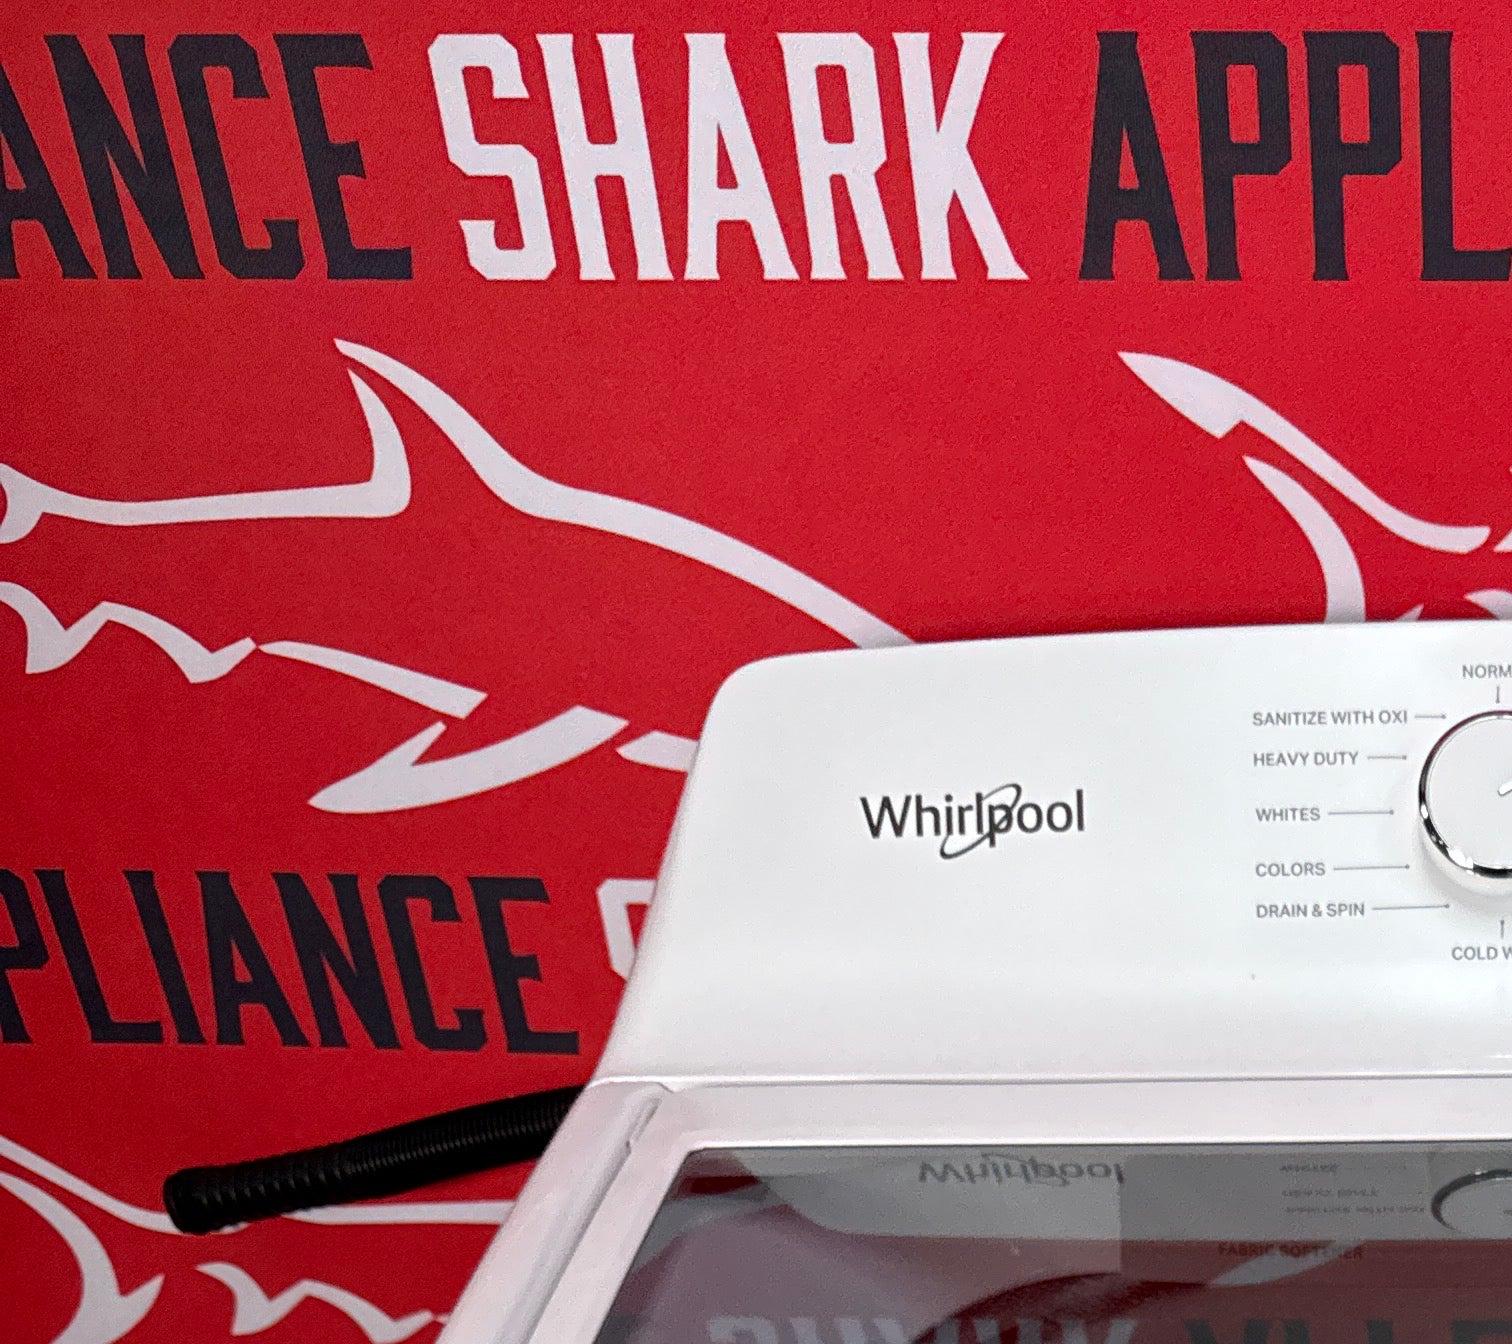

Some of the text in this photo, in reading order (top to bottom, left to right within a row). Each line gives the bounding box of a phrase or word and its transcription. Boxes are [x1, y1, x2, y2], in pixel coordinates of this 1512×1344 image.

[427, 31, 1029, 282] SHARK
[1252, 709, 1408, 726] SANITIZE WITH OXI
[1253, 751, 1359, 767] HEAVY DUTY
[859, 783, 1085, 860] Whirlpool
[1255, 807, 1321, 822] WHITES
[1255, 862, 1326, 878] COLORS
[1256, 903, 1365, 918] DRAIN & SPIN
[1451, 946, 1498, 961] COLD
